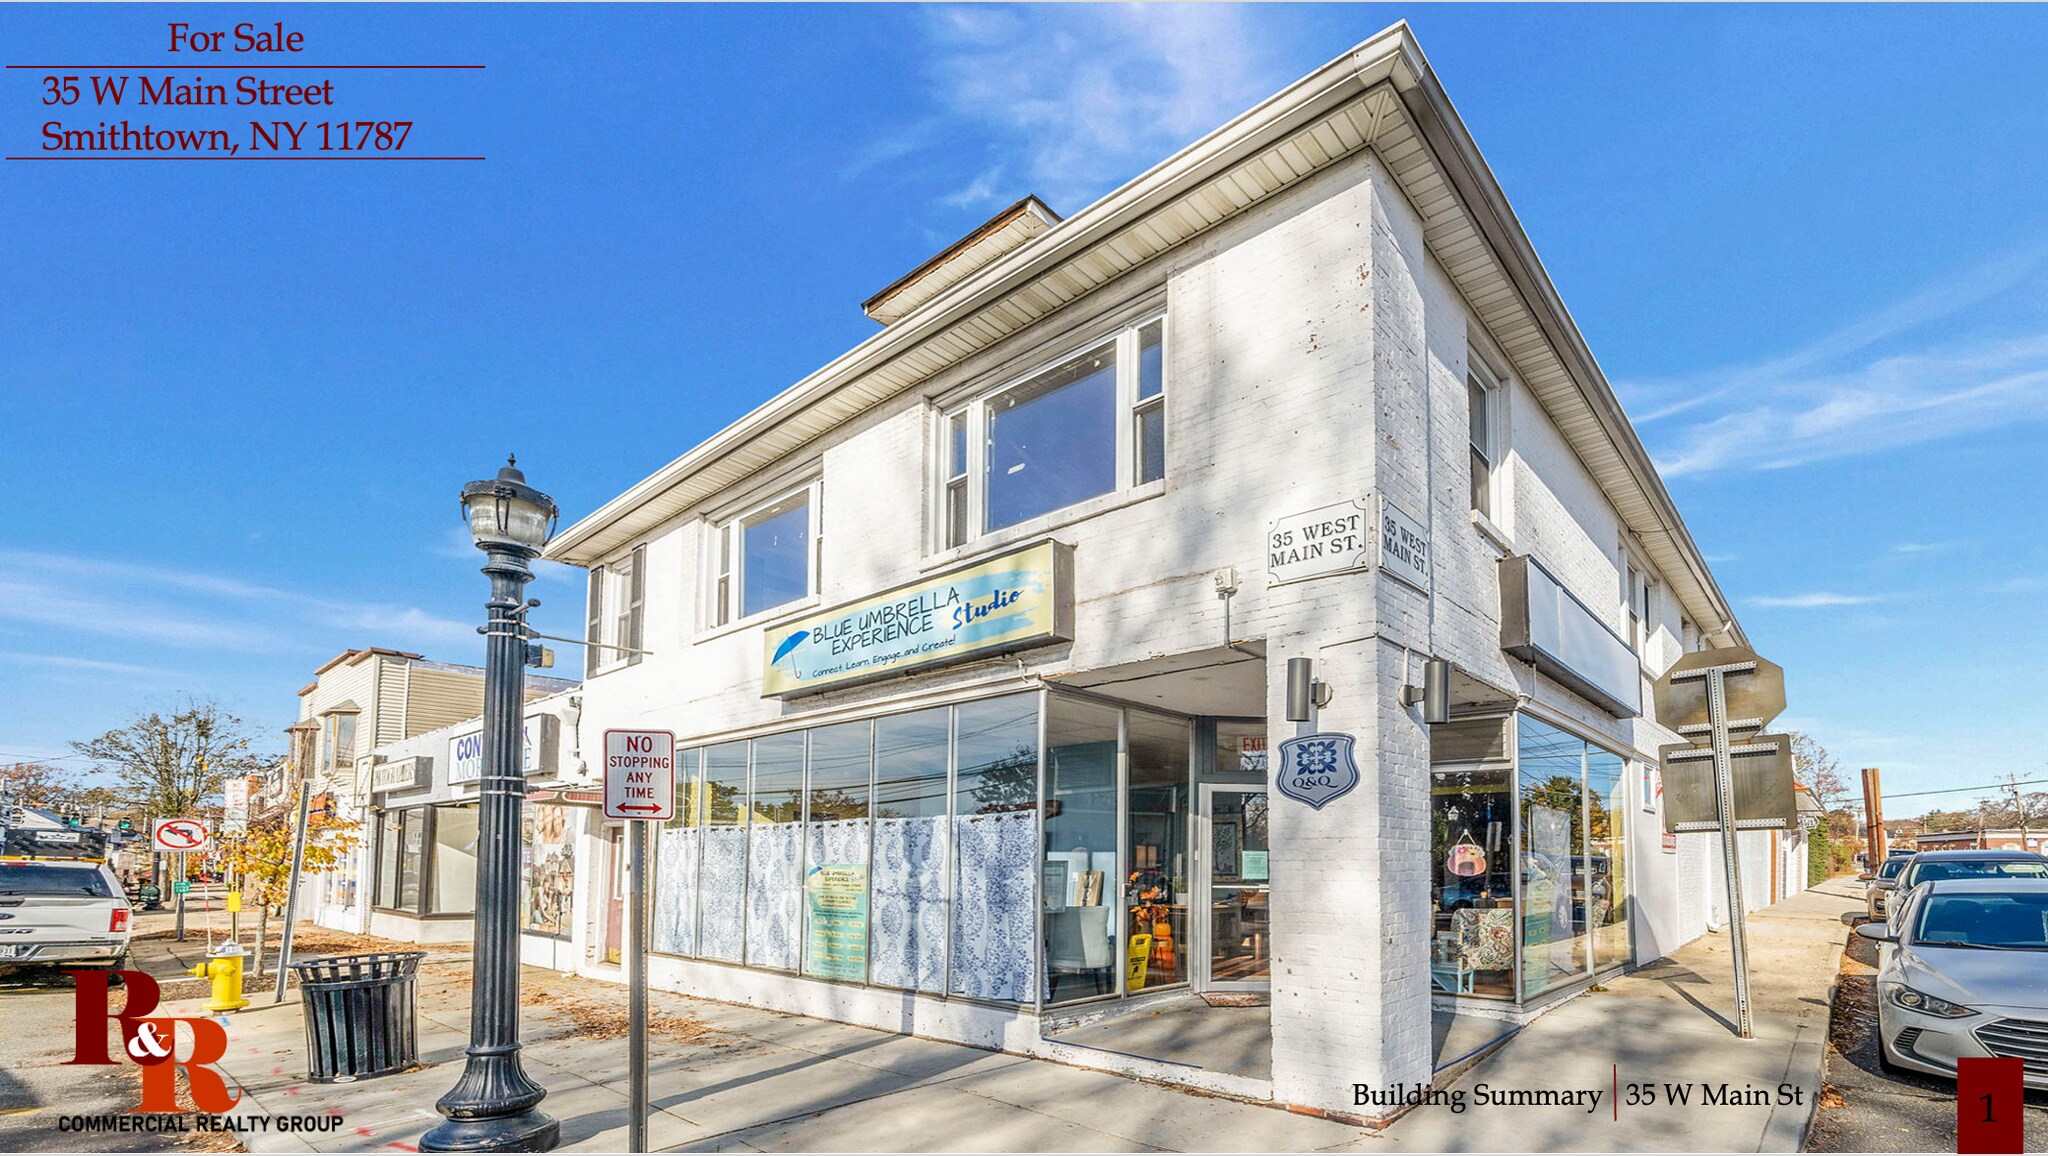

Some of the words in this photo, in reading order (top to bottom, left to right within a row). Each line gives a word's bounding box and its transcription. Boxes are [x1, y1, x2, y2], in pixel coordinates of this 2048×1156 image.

[1272, 530, 1294, 549] 35
[1302, 514, 1360, 541] WEST
[1384, 515, 1397, 537] 35
[1399, 525, 1428, 557] WEST
[1270, 542, 1324, 568] MAIN
[1329, 534, 1364, 554] ST.
[1383, 534, 1412, 565] MAIN
[1413, 556, 1429, 577] ST.
[812, 618, 853, 644] BLUE
[858, 586, 960, 631] UMBRELLA
[952, 589, 1025, 631] Studio
[832, 613, 934, 656] EXPERIENCE
[921, 633, 956, 652] Create!
[626, 736, 653, 753] NO
[610, 756, 670, 769] STOPPING
[626, 772, 653, 784] ANY
[624, 787, 655, 799] TIME
[1292, 775, 1339, 790] Q&Q
